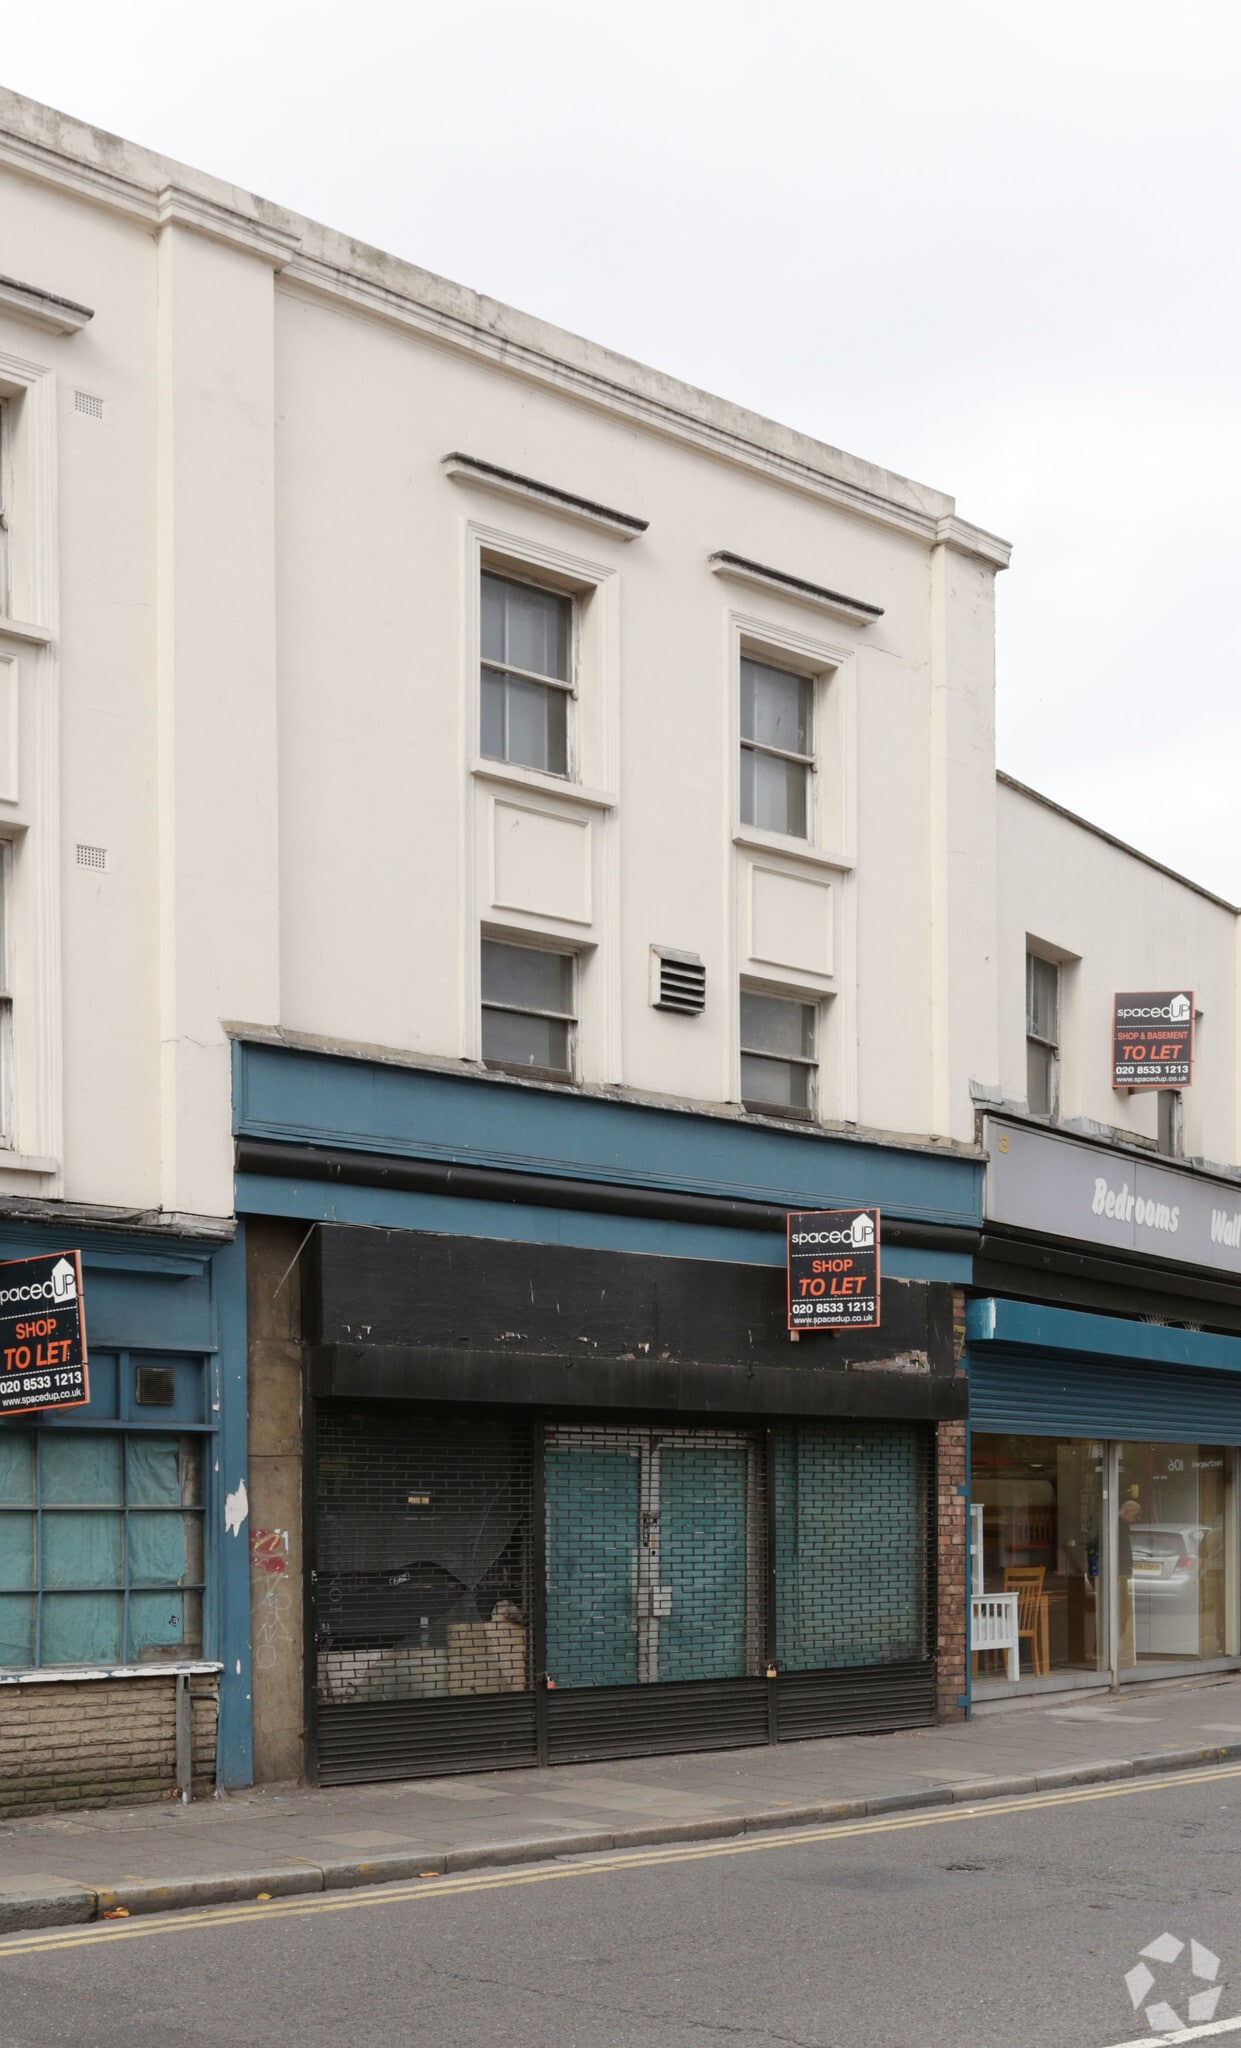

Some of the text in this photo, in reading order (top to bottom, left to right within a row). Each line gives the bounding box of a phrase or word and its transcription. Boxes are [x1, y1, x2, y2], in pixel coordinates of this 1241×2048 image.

[1117, 1031, 1188, 1040] SHOP & BASEMENT
[1122, 1044, 1183, 1060] TO LET
[1115, 1065, 1189, 1075] 020 8533 1213
[1091, 1177, 1181, 1233] Bedrooms
[812, 1259, 853, 1273] SHOP
[0, 1273, 75, 1306] pacedUP
[799, 1276, 867, 1296] TO LET
[792, 1302, 874, 1314] 020 8533 1213
[16, 1318, 57, 1340] SHOP
[794, 1315, 873, 1325] www.spacedup.co.uk
[4, 1340, 72, 1371] TO LET
[0, 1371, 82, 1395] 020 8533 1213
[2, 1388, 82, 1406] www.spacedup.co.uk
